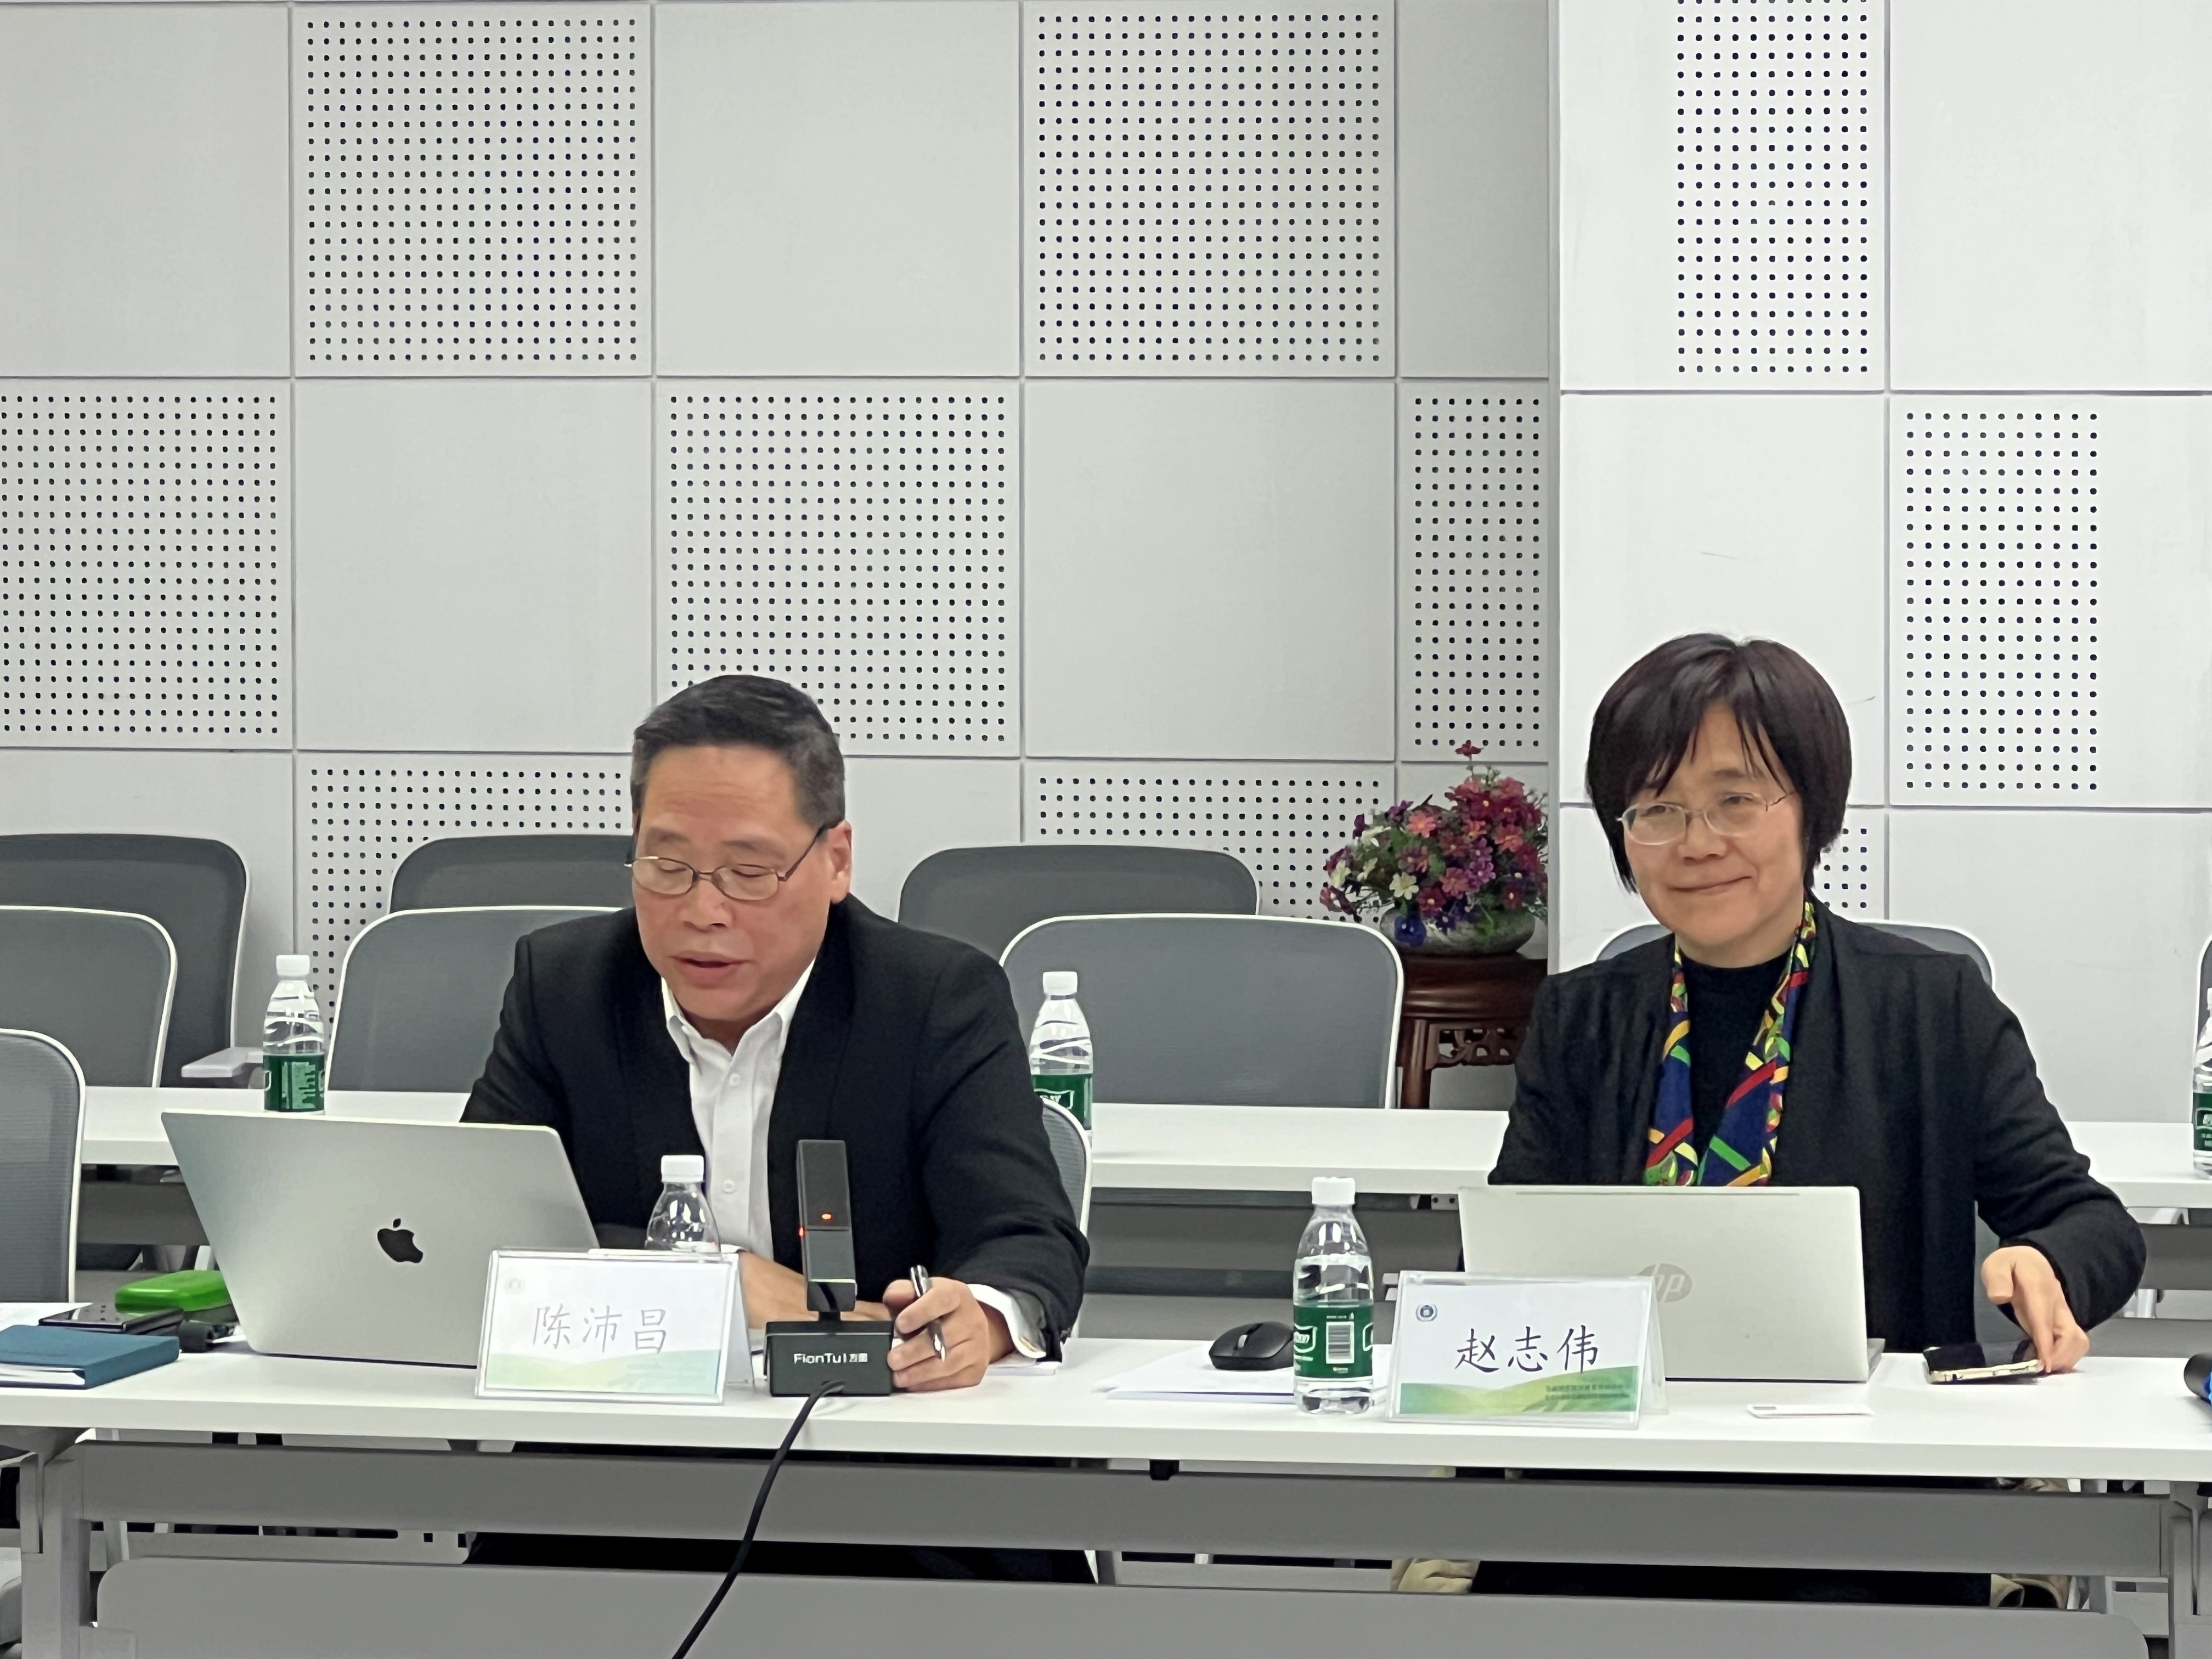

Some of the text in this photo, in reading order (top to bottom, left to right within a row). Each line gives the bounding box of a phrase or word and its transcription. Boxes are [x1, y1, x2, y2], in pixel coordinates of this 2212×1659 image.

[532, 1304, 667, 1354] 陈沛昌
[1454, 1324, 1599, 1374] 赵志伟
